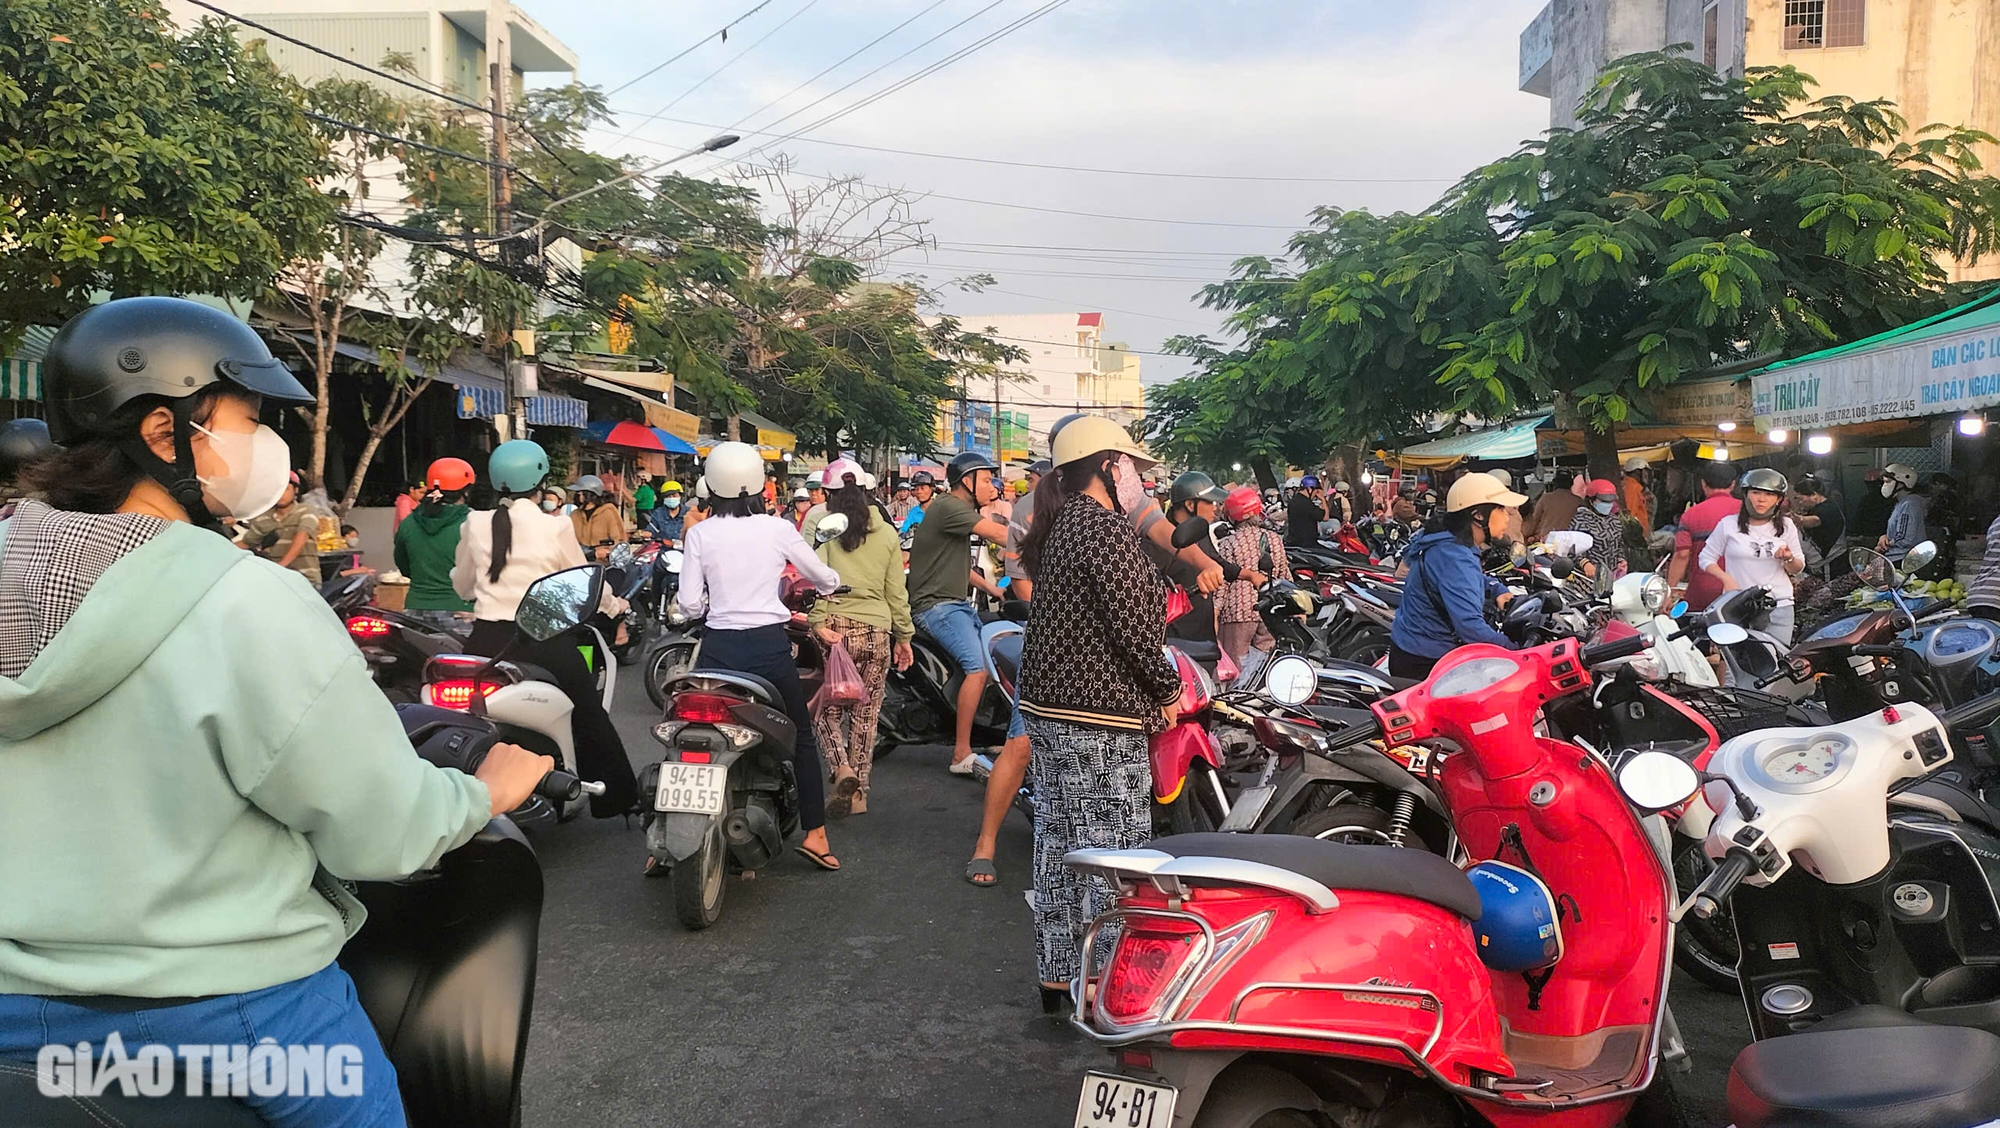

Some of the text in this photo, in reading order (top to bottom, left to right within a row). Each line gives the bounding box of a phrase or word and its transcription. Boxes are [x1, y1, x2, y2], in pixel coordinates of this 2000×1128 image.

[1931, 344, 1957, 369] BÁN
[1961, 337, 1985, 364] CÁC
[1774, 377, 1797, 412] TRÁI
[1799, 373, 1821, 408] CÂY
[1921, 380, 1940, 405] TRÁI
[1943, 376, 1965, 401] CÂY
[660, 788, 719, 810] 099.55
